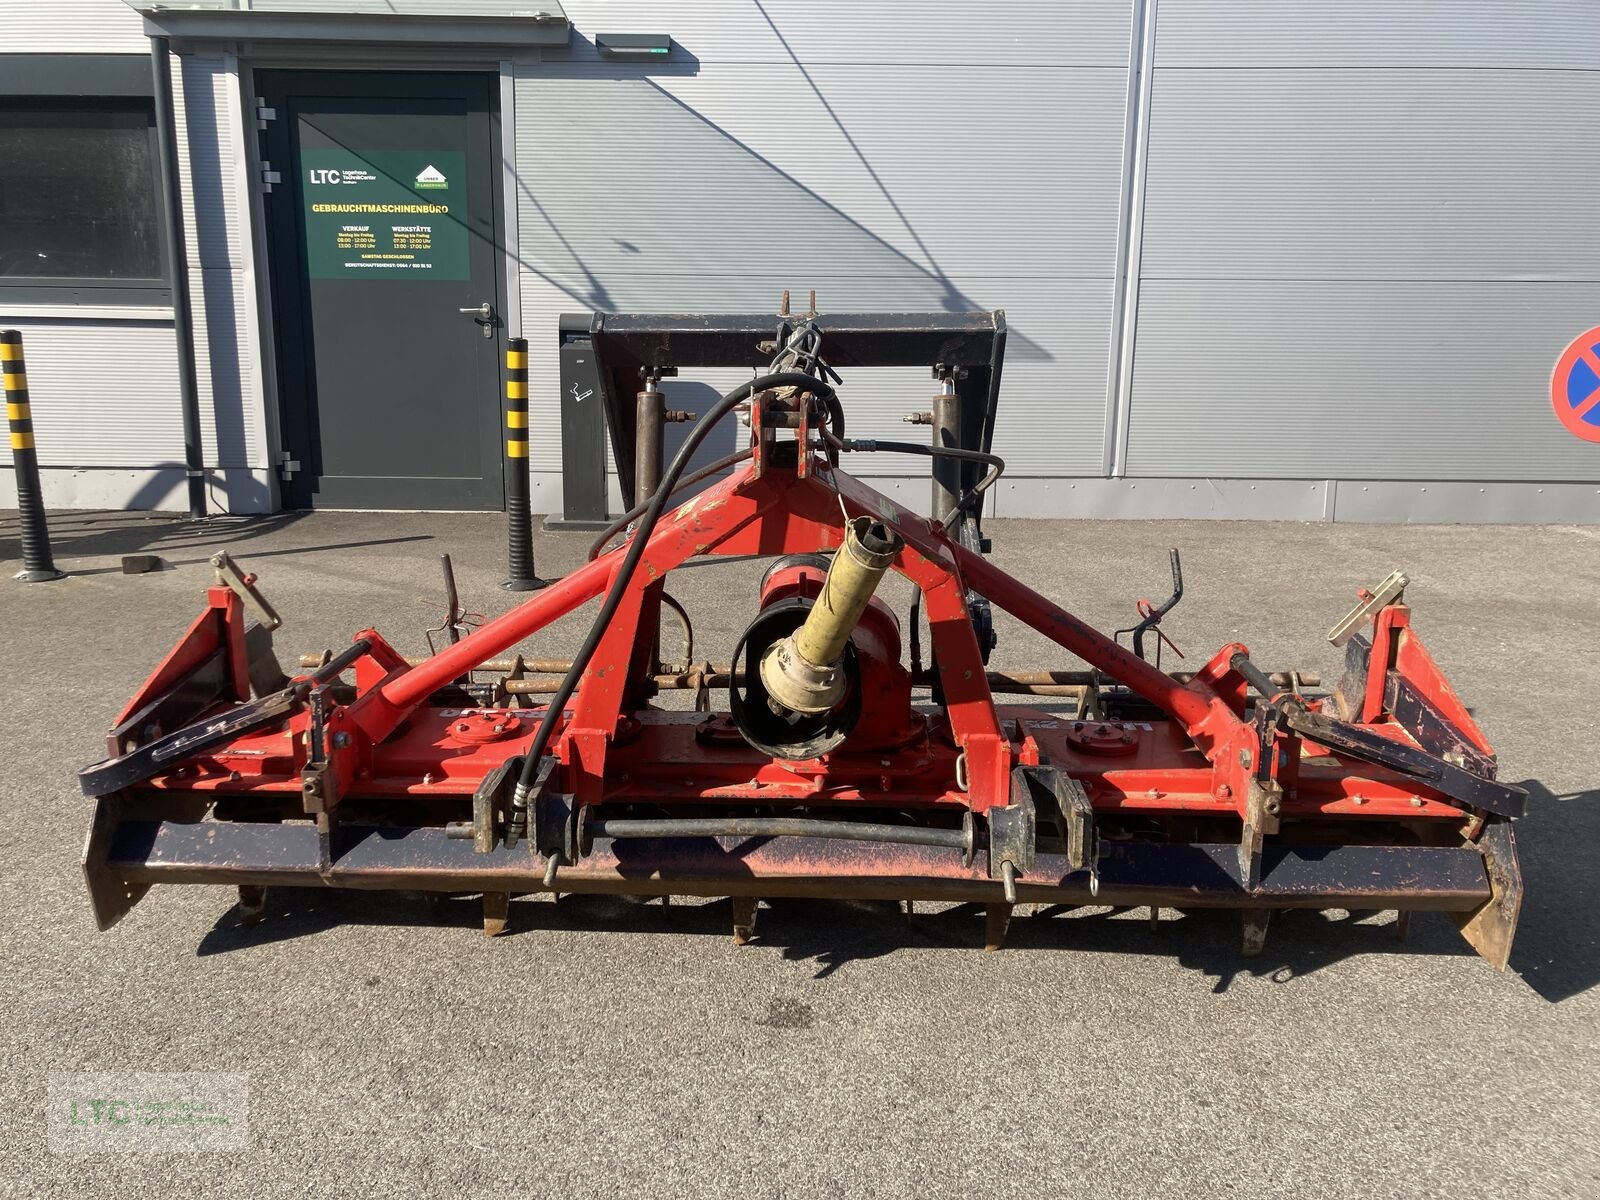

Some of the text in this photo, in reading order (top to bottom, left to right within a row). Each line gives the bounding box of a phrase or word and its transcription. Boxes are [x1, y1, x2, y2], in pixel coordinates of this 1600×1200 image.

[310, 169, 340, 184] LTC
[312, 203, 449, 214] GEBRAUCHTMASCHINENBÜRO
[391, 225, 432, 233] WERKSTÄTTE
